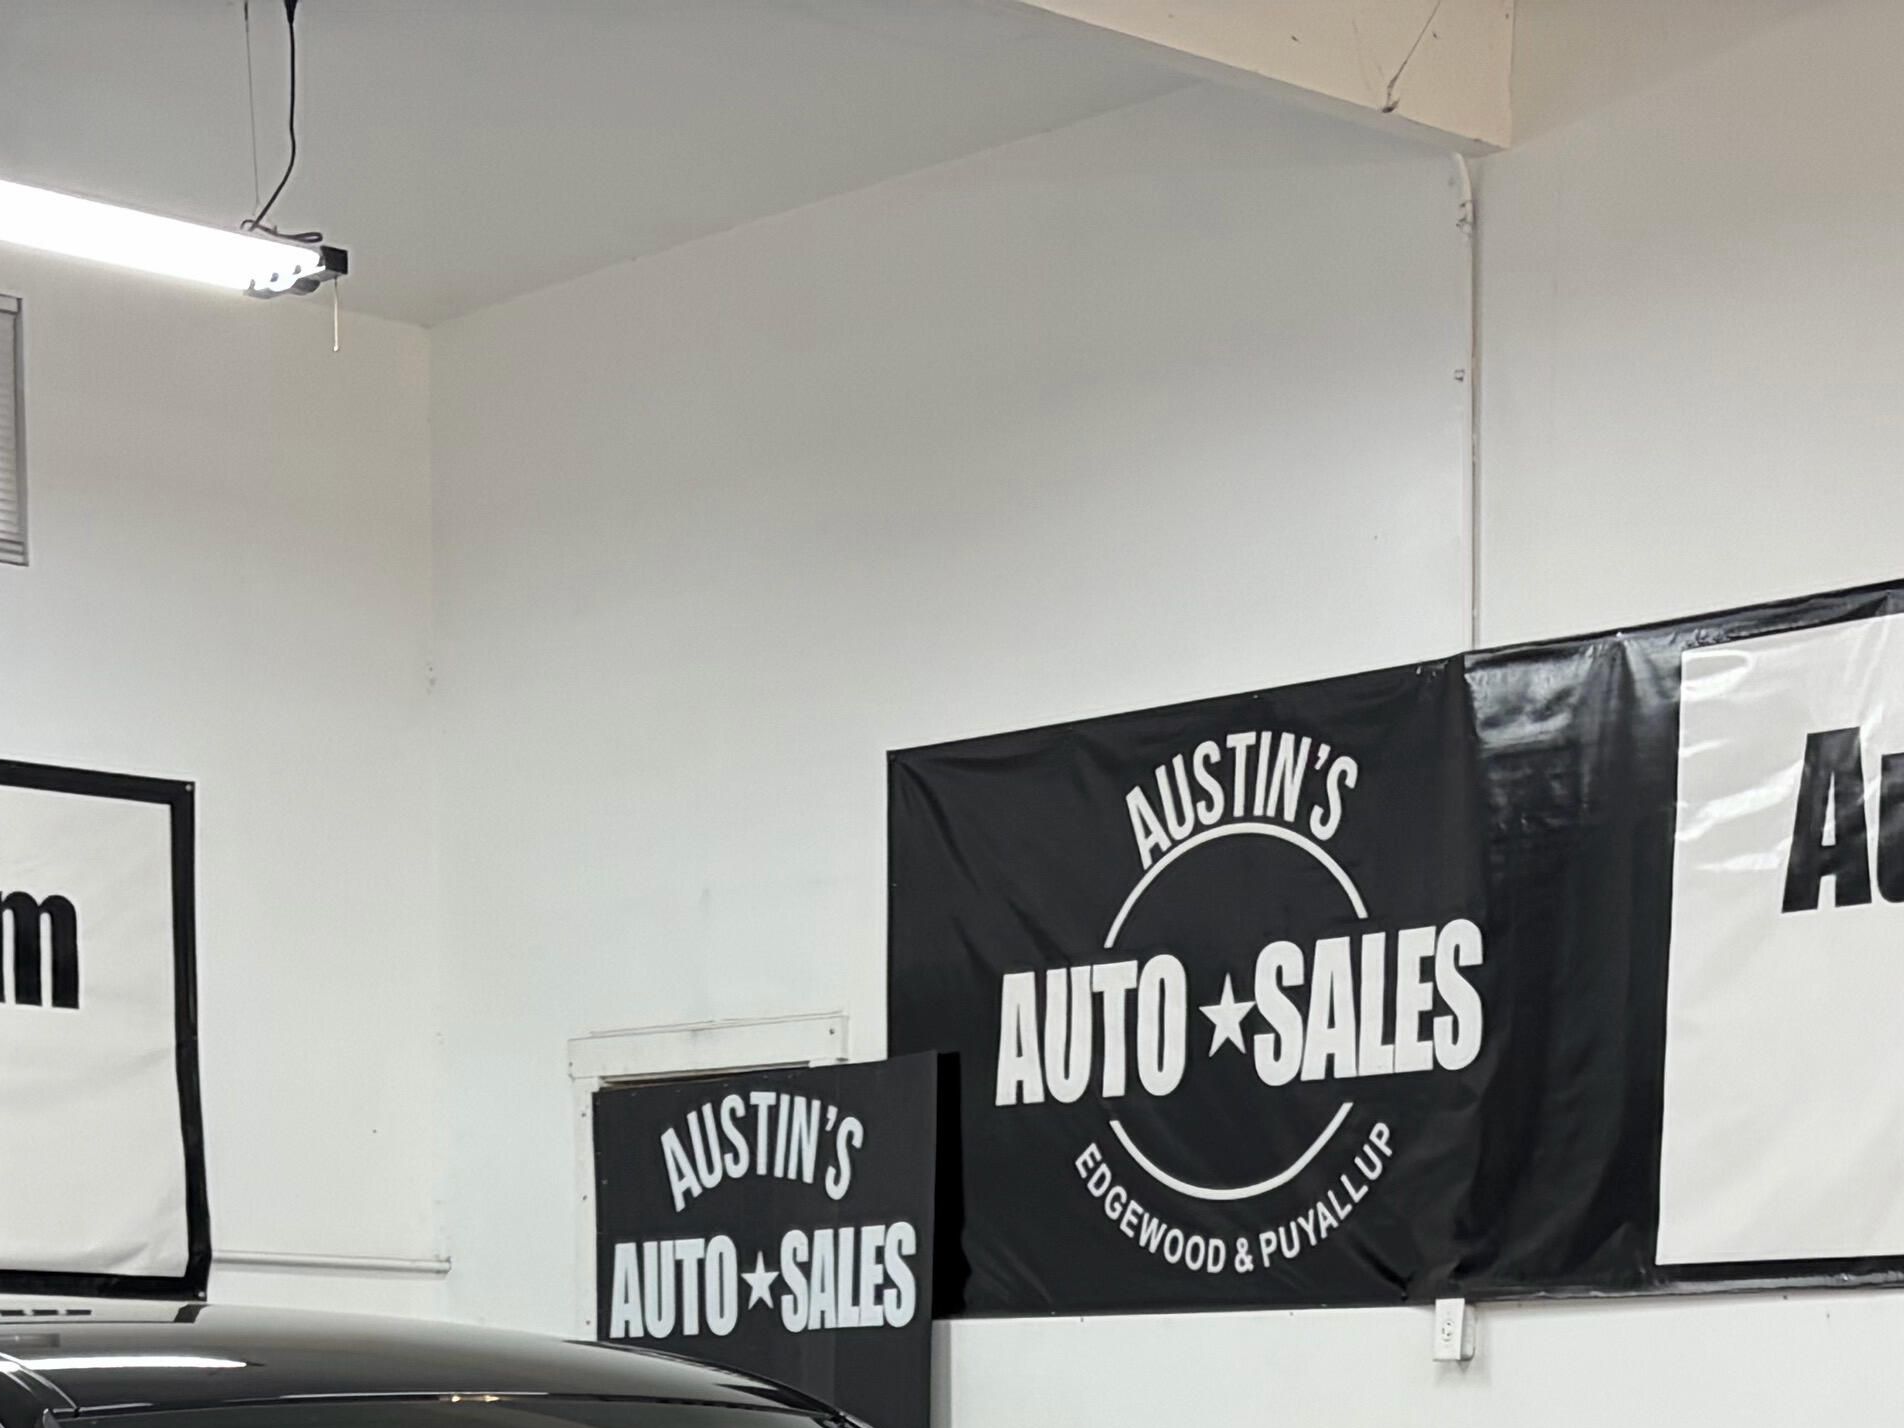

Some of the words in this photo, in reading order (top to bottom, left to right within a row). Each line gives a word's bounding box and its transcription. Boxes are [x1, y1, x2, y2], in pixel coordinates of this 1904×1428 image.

[1126, 732, 1358, 869] AUSTIN'S
[996, 955, 1187, 1105] AUTO
[1253, 919, 1483, 1087] SALES
[661, 1092, 863, 1212] AUSTIN'S
[1075, 1142, 1226, 1274] EDGEWOOD
[1234, 1237, 1254, 1273] &
[1259, 1122, 1393, 1268] PUYALLUP
[609, 1235, 738, 1339] AUTO
[780, 1221, 916, 1333] SALES
